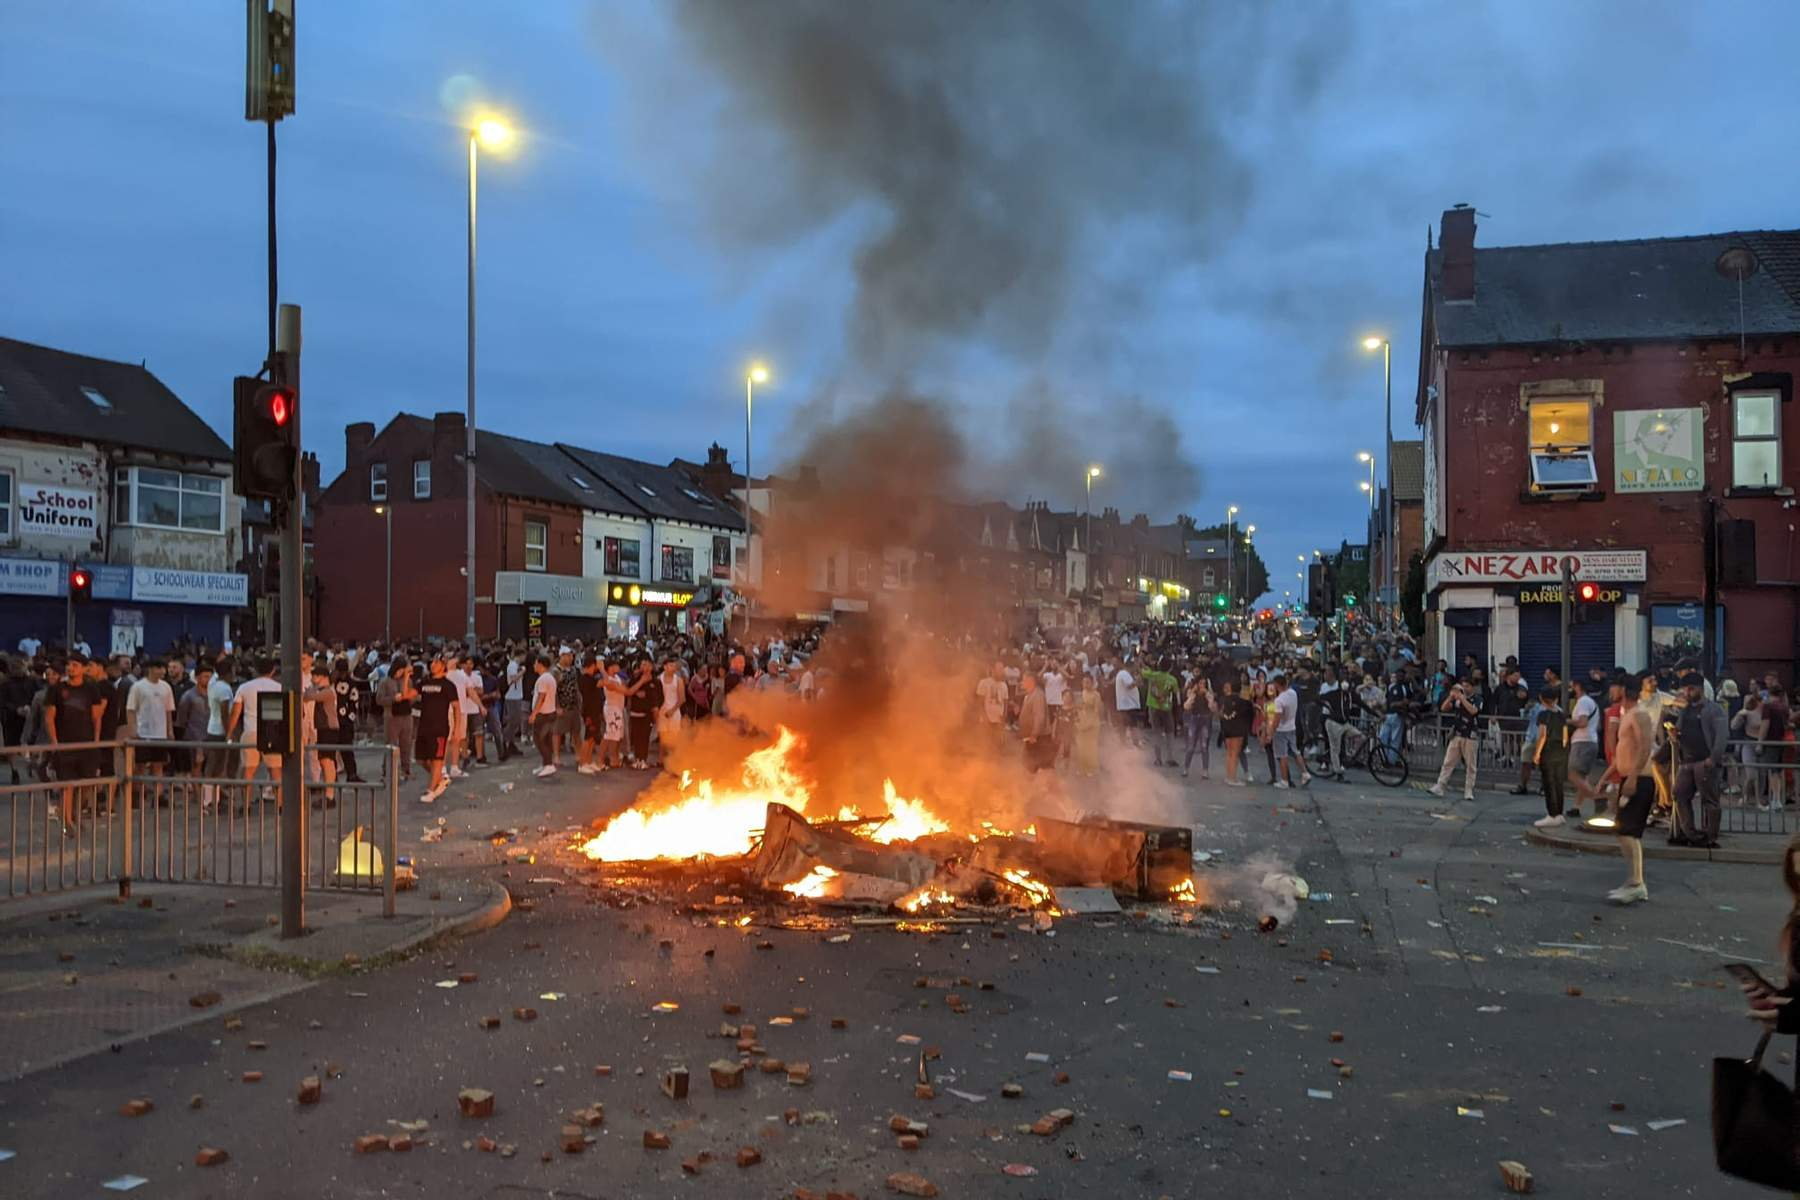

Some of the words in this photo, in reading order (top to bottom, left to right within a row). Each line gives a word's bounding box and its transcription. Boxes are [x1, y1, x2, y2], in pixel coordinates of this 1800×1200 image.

[28, 490, 93, 510] School
[19, 504, 94, 528] Uniform
[15, 565, 52, 577] SHOP
[1465, 555, 1581, 580] NEZARO
[154, 571, 205, 589] SCHOOLWEAR
[207, 575, 245, 592] SPECIALIST
